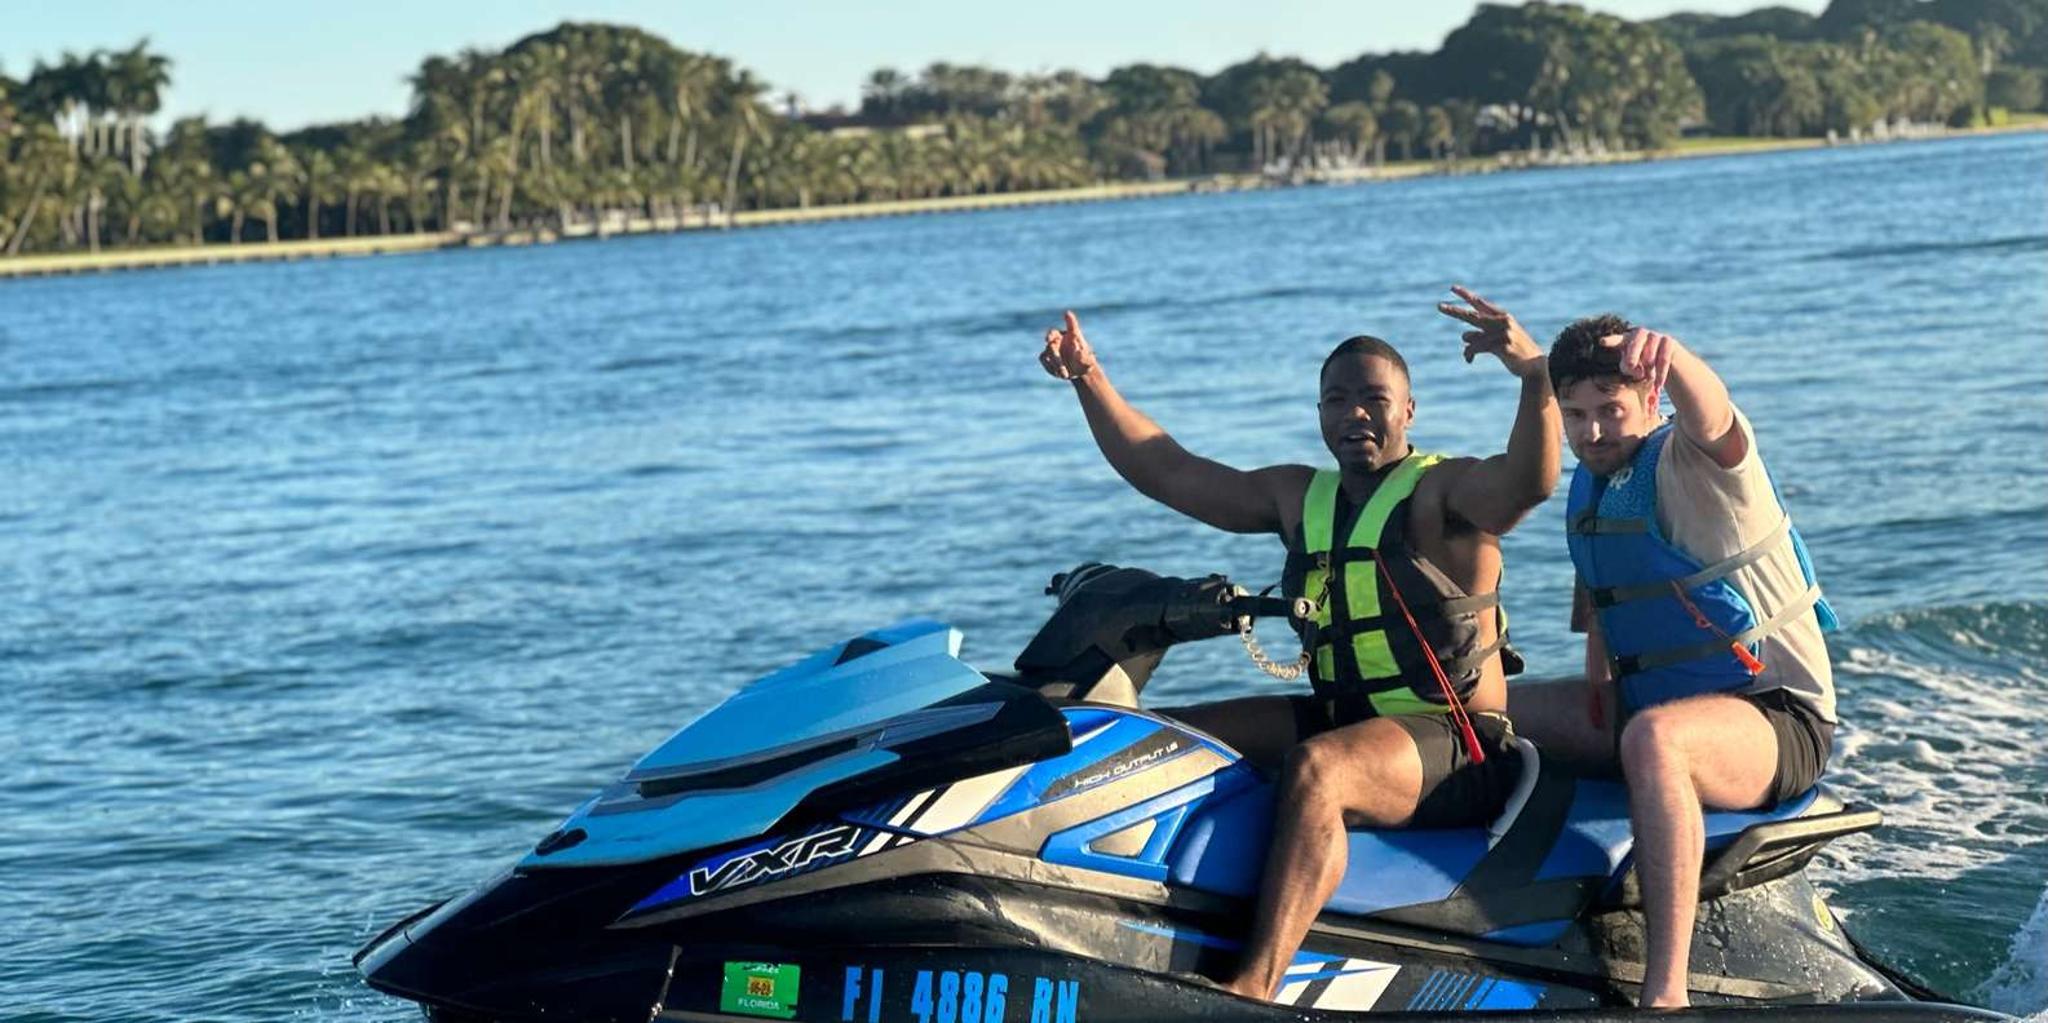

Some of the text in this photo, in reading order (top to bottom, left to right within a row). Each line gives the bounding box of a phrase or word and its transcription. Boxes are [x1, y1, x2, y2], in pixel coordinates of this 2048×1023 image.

[1114, 749, 1165, 774] OUTPUT
[690, 826, 862, 896] VXR
[738, 997, 780, 1010] FLORIDA
[911, 970, 1009, 1023] 4886
[1030, 976, 1080, 1023] RN
